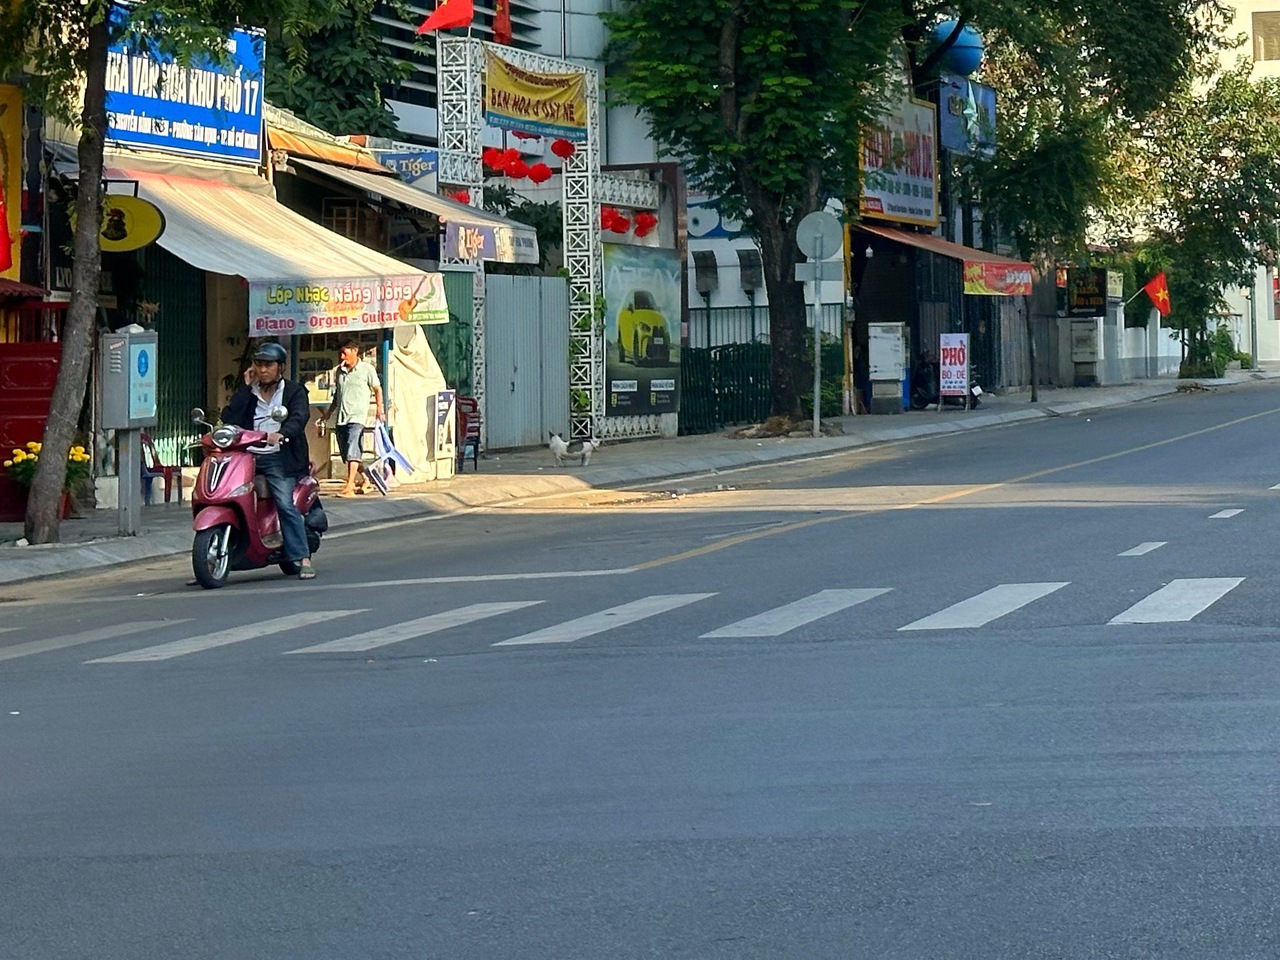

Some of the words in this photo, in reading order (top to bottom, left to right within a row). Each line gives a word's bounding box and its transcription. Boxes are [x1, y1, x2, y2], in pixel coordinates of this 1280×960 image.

[189, 68, 215, 109] KHU
[244, 80, 260, 116] 17
[399, 157, 436, 176] Tiger
[266, 284, 293, 307] Lớp
[296, 285, 330, 307] Nhạc
[256, 315, 296, 331] Piano
[309, 315, 348, 328] Organ
[361, 309, 400, 324] Guitar
[942, 340, 966, 366] PHỞ
